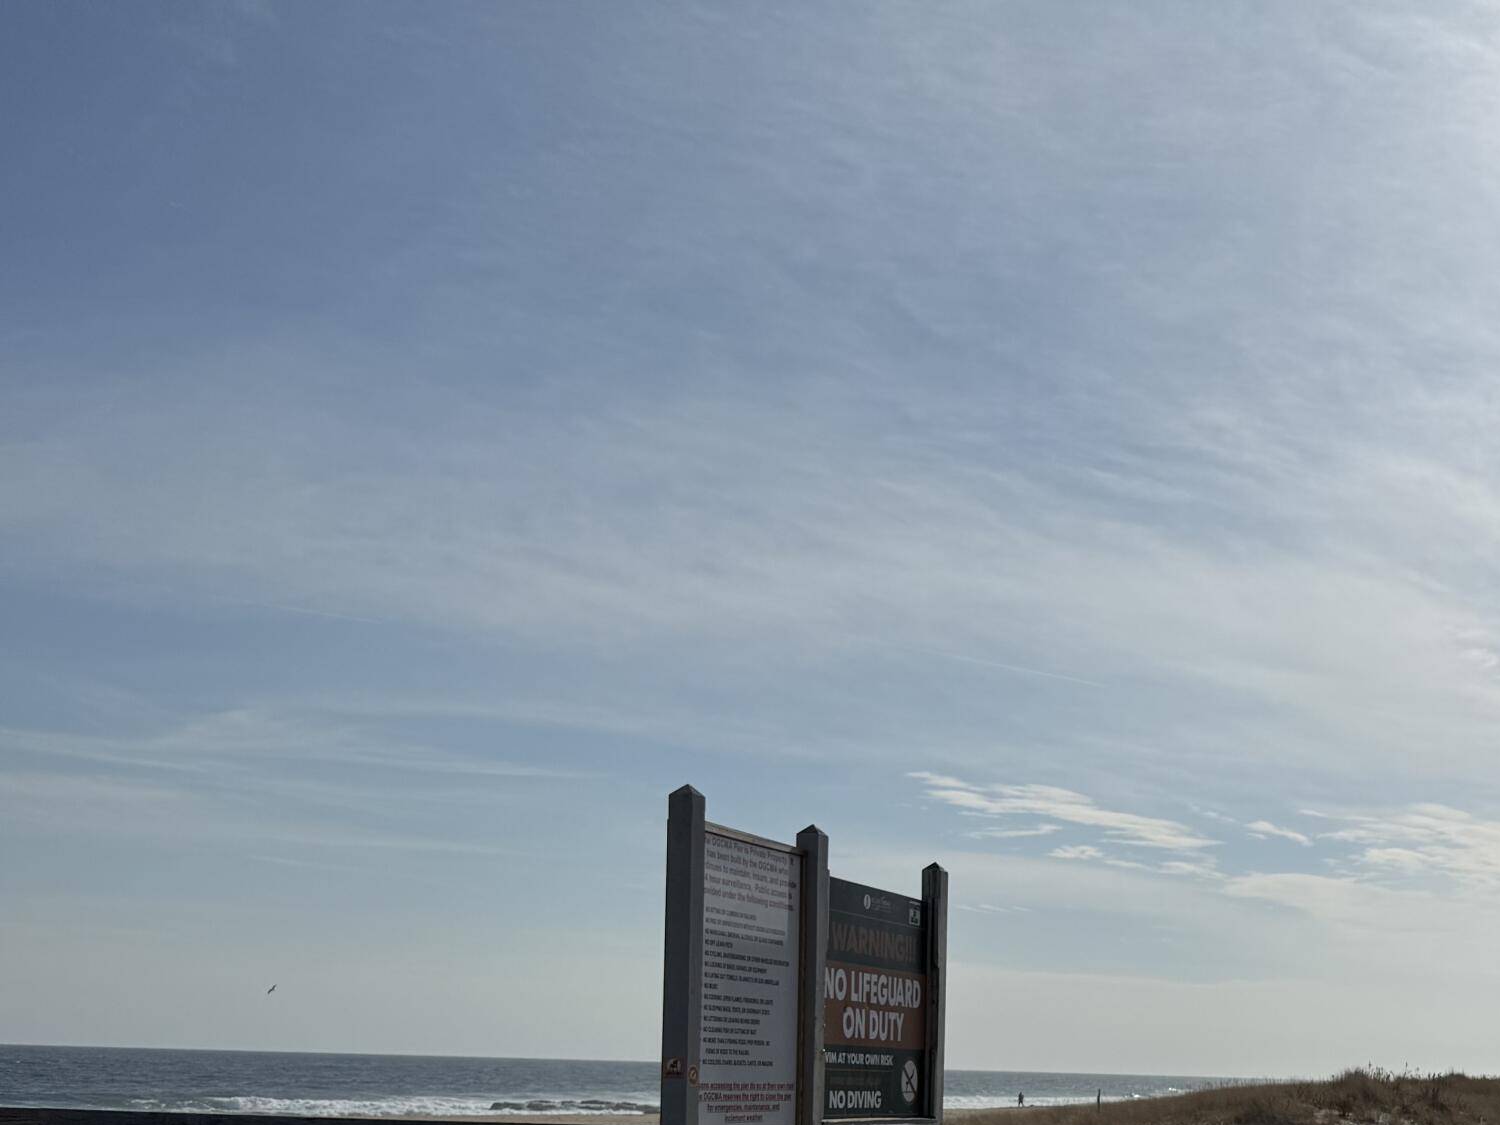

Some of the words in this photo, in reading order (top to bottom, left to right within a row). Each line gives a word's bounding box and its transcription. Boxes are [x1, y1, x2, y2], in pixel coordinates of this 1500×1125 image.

[824, 967, 847, 1001] NO
[851, 970, 921, 1009] LIFEGUARD
[842, 1007, 865, 1039] ON
[869, 1010, 904, 1042] DUTY
[838, 1052, 846, 1064] AT
[847, 1053, 864, 1065] YOUR
[865, 1054, 880, 1066] OWN
[881, 1054, 894, 1066] RISK
[829, 1090, 846, 1109] NO
[847, 1090, 882, 1109] DIVING
